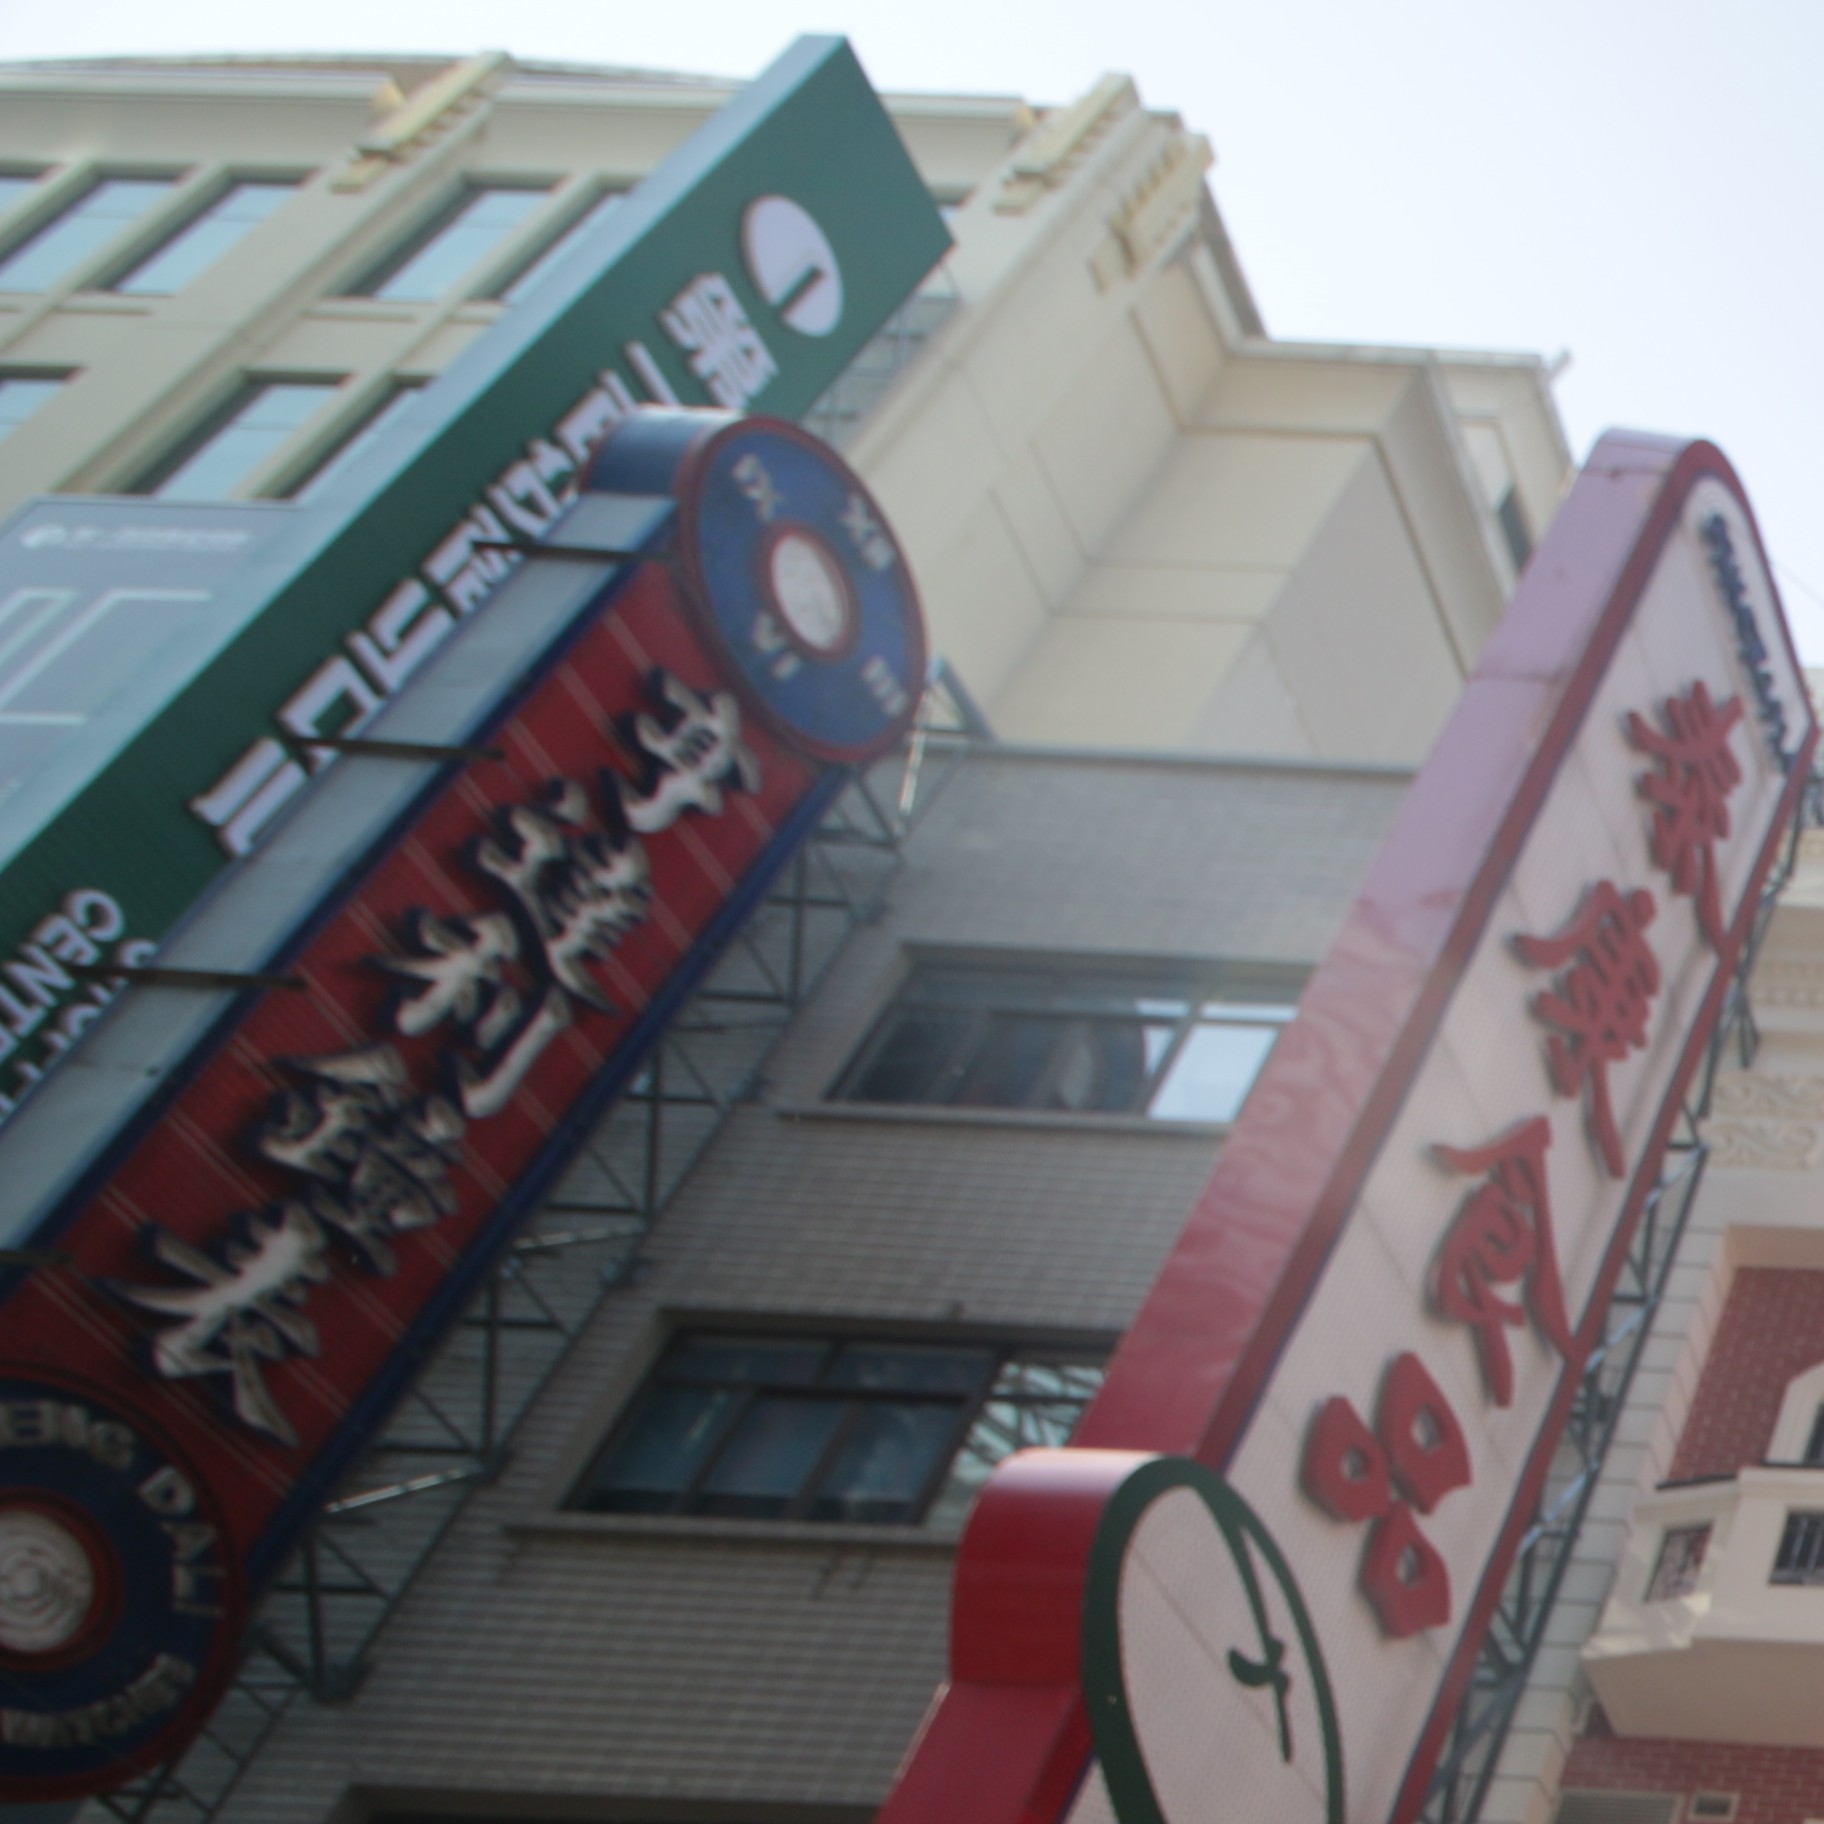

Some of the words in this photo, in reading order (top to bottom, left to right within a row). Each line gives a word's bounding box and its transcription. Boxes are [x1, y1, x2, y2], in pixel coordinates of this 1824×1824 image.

[0, 885, 125, 1068] CENT
[1300, 677, 1746, 1640] 泰康食品
